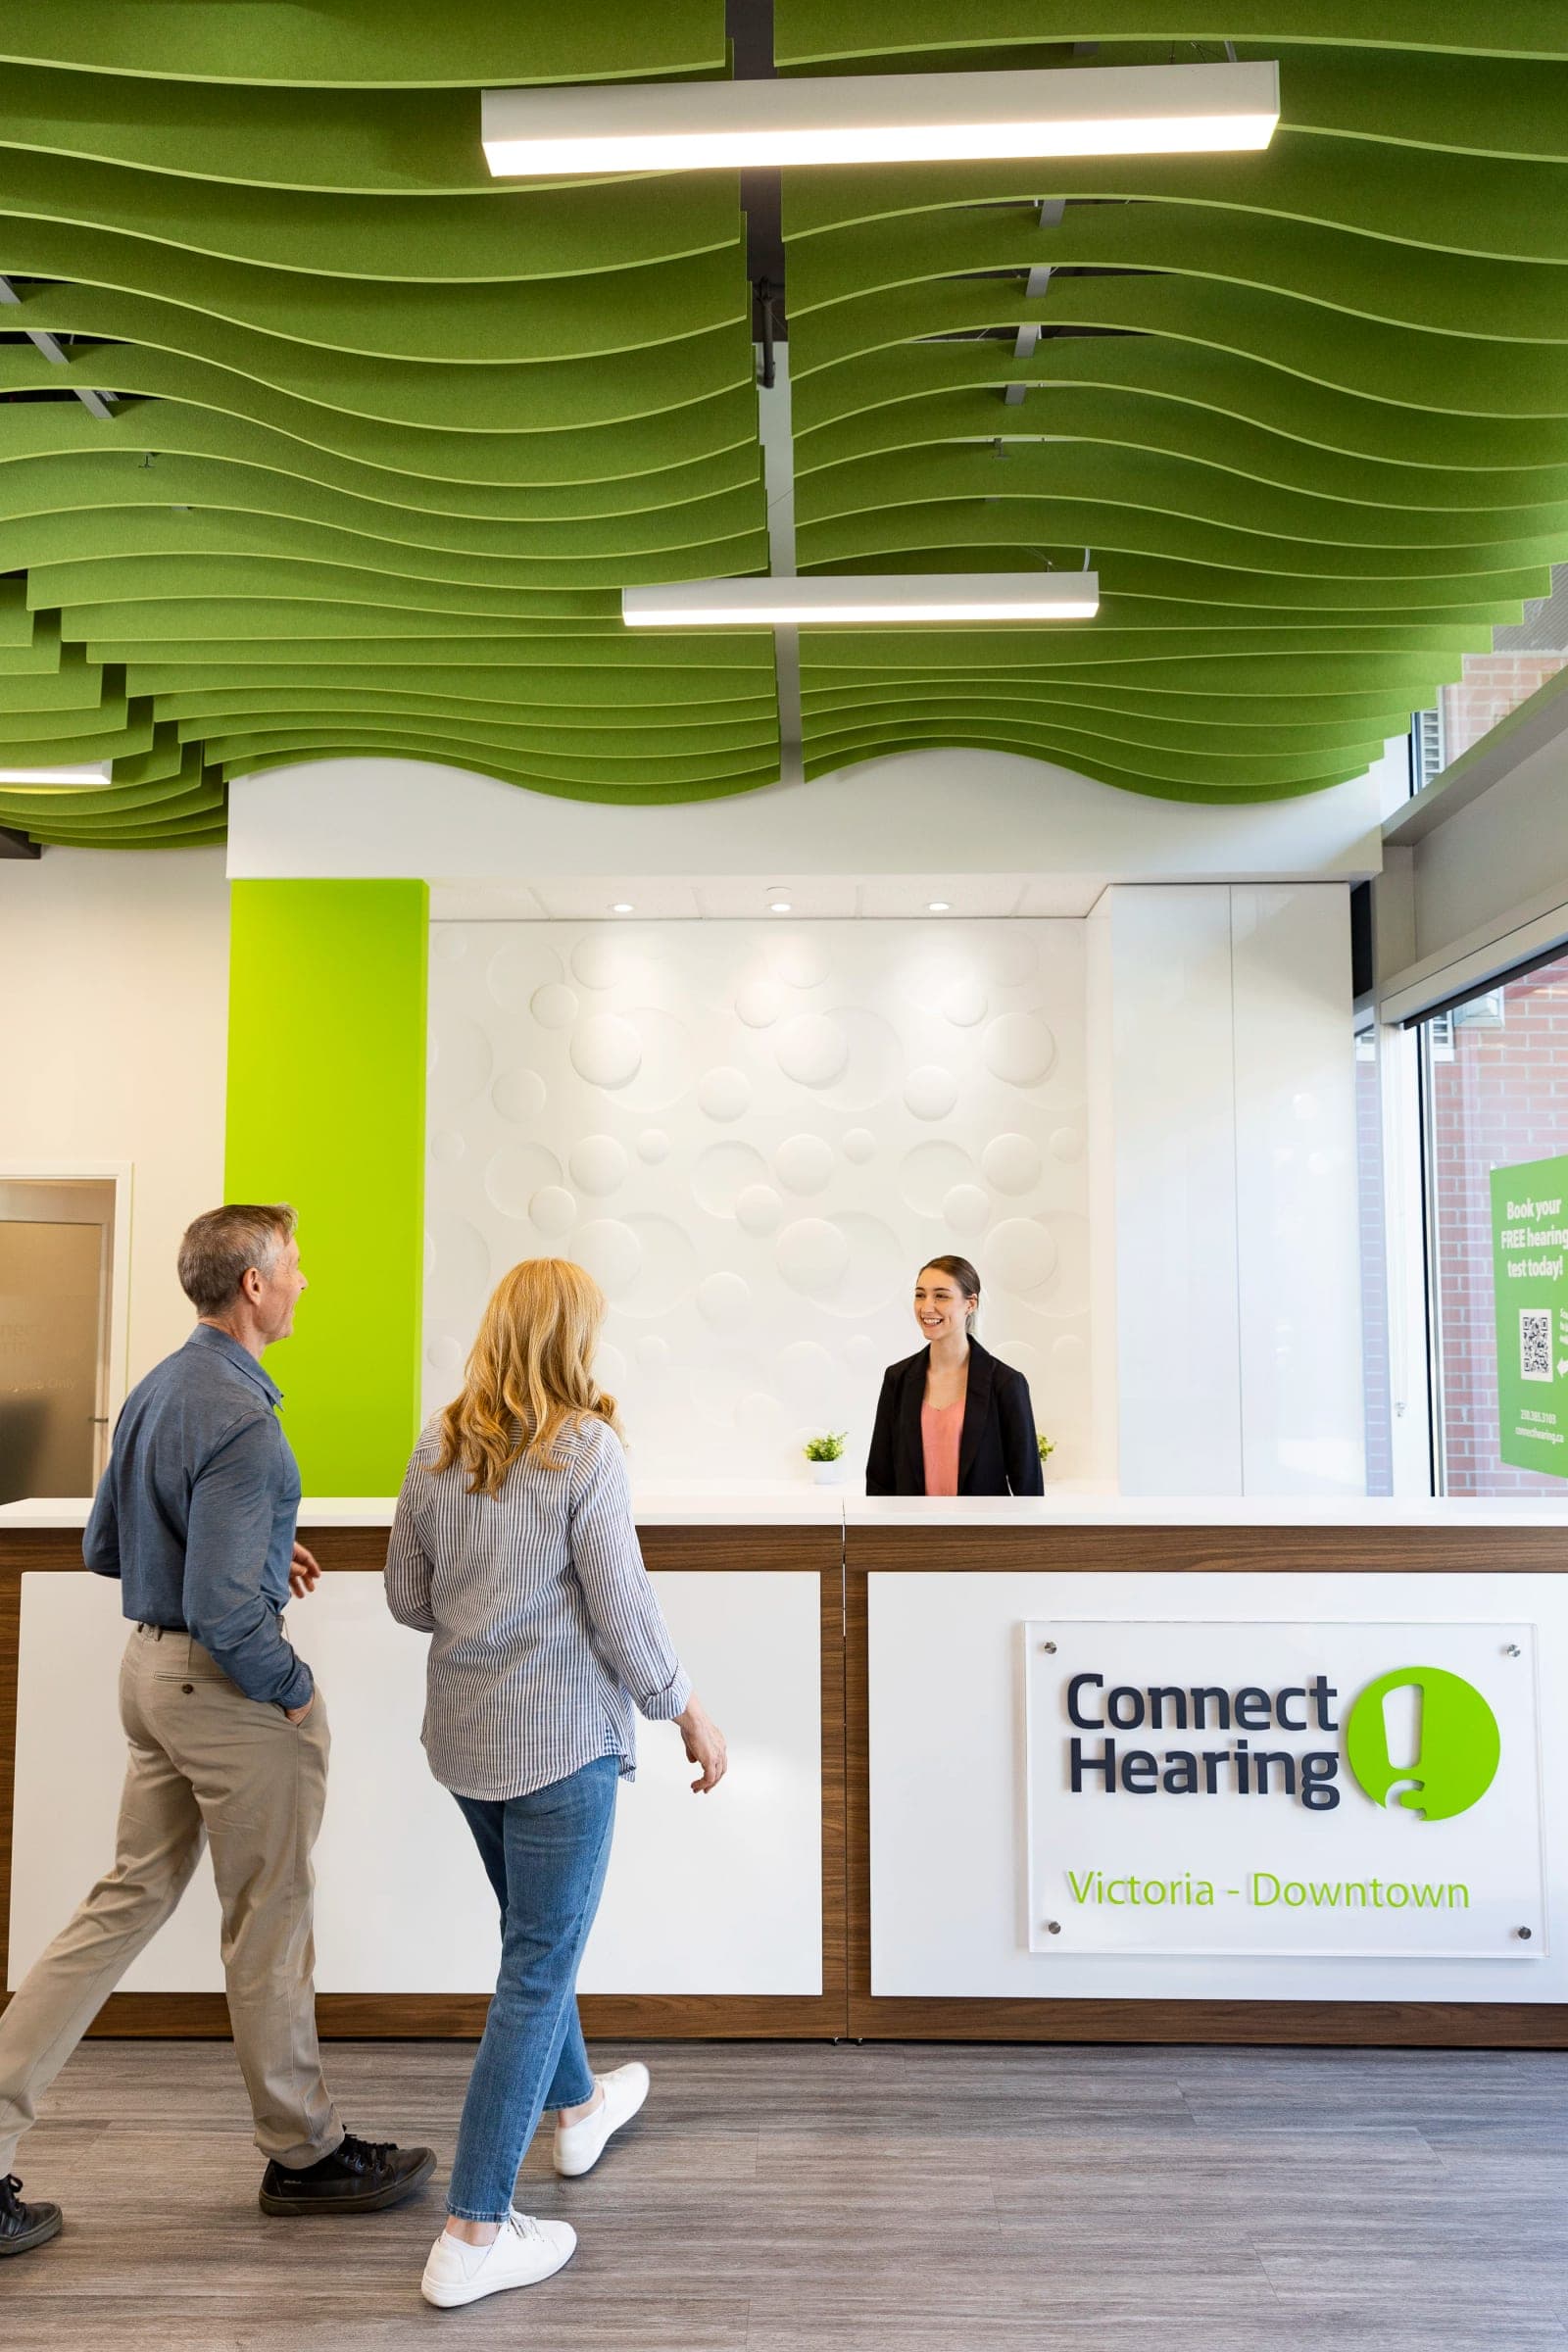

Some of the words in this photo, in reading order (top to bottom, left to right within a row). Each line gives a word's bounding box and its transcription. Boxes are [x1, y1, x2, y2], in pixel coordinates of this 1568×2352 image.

[1507, 1198, 1534, 1219] Book
[1535, 1199, 1562, 1221] your
[1501, 1229, 1525, 1250] FREE
[1527, 1224, 1568, 1250] hearing
[1507, 1260, 1527, 1278] test
[1528, 1254, 1563, 1281] today!
[1067, 1673, 1339, 1732] Connect
[1070, 1738, 1341, 1811] Hearing
[1068, 1870, 1214, 1906] Victoria
[1252, 1872, 1469, 1908] Downtown
